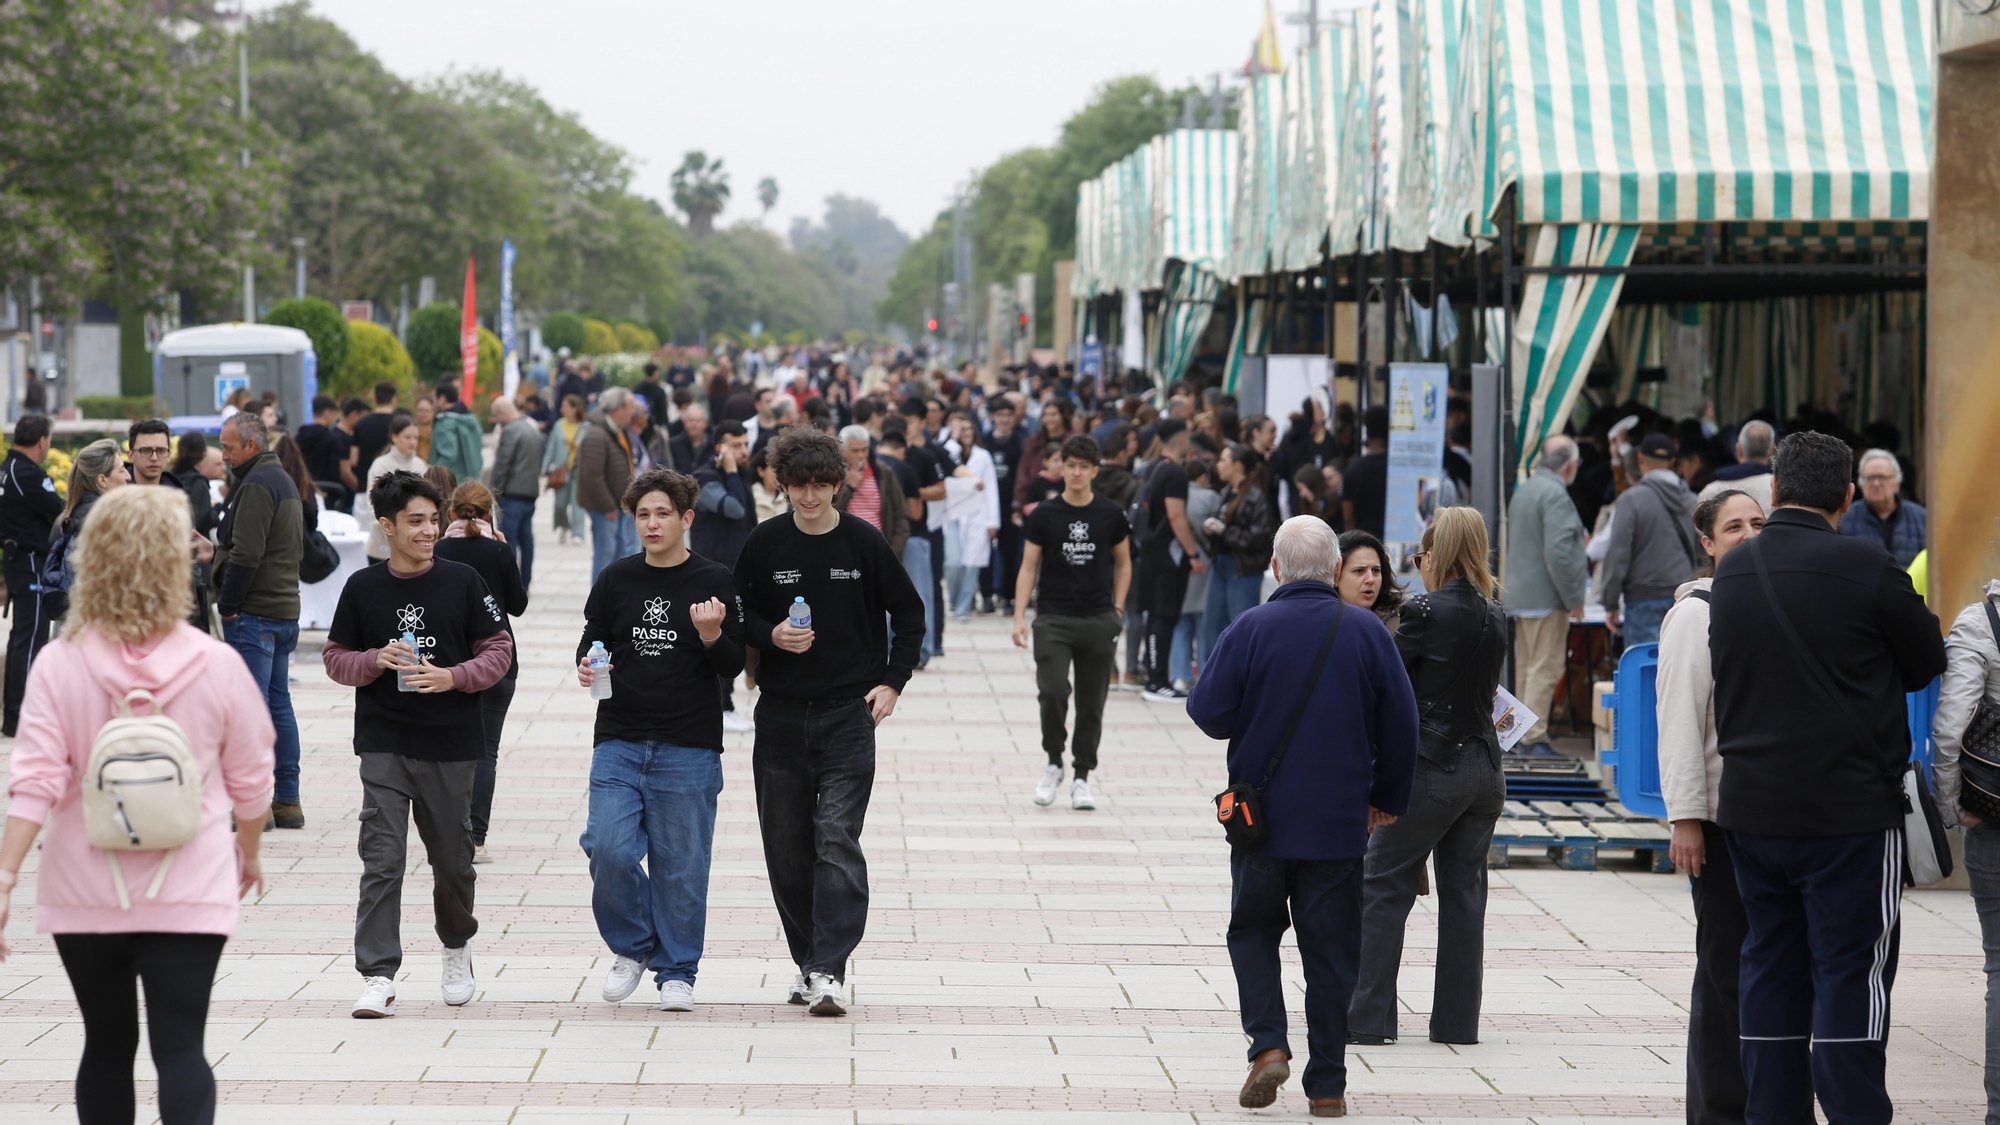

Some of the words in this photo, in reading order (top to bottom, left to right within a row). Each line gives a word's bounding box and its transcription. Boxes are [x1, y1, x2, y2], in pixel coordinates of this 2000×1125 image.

[1062, 542, 1096, 552] PASEO
[632, 627, 678, 641] PASEO
[634, 640, 675, 651] Ciencia
